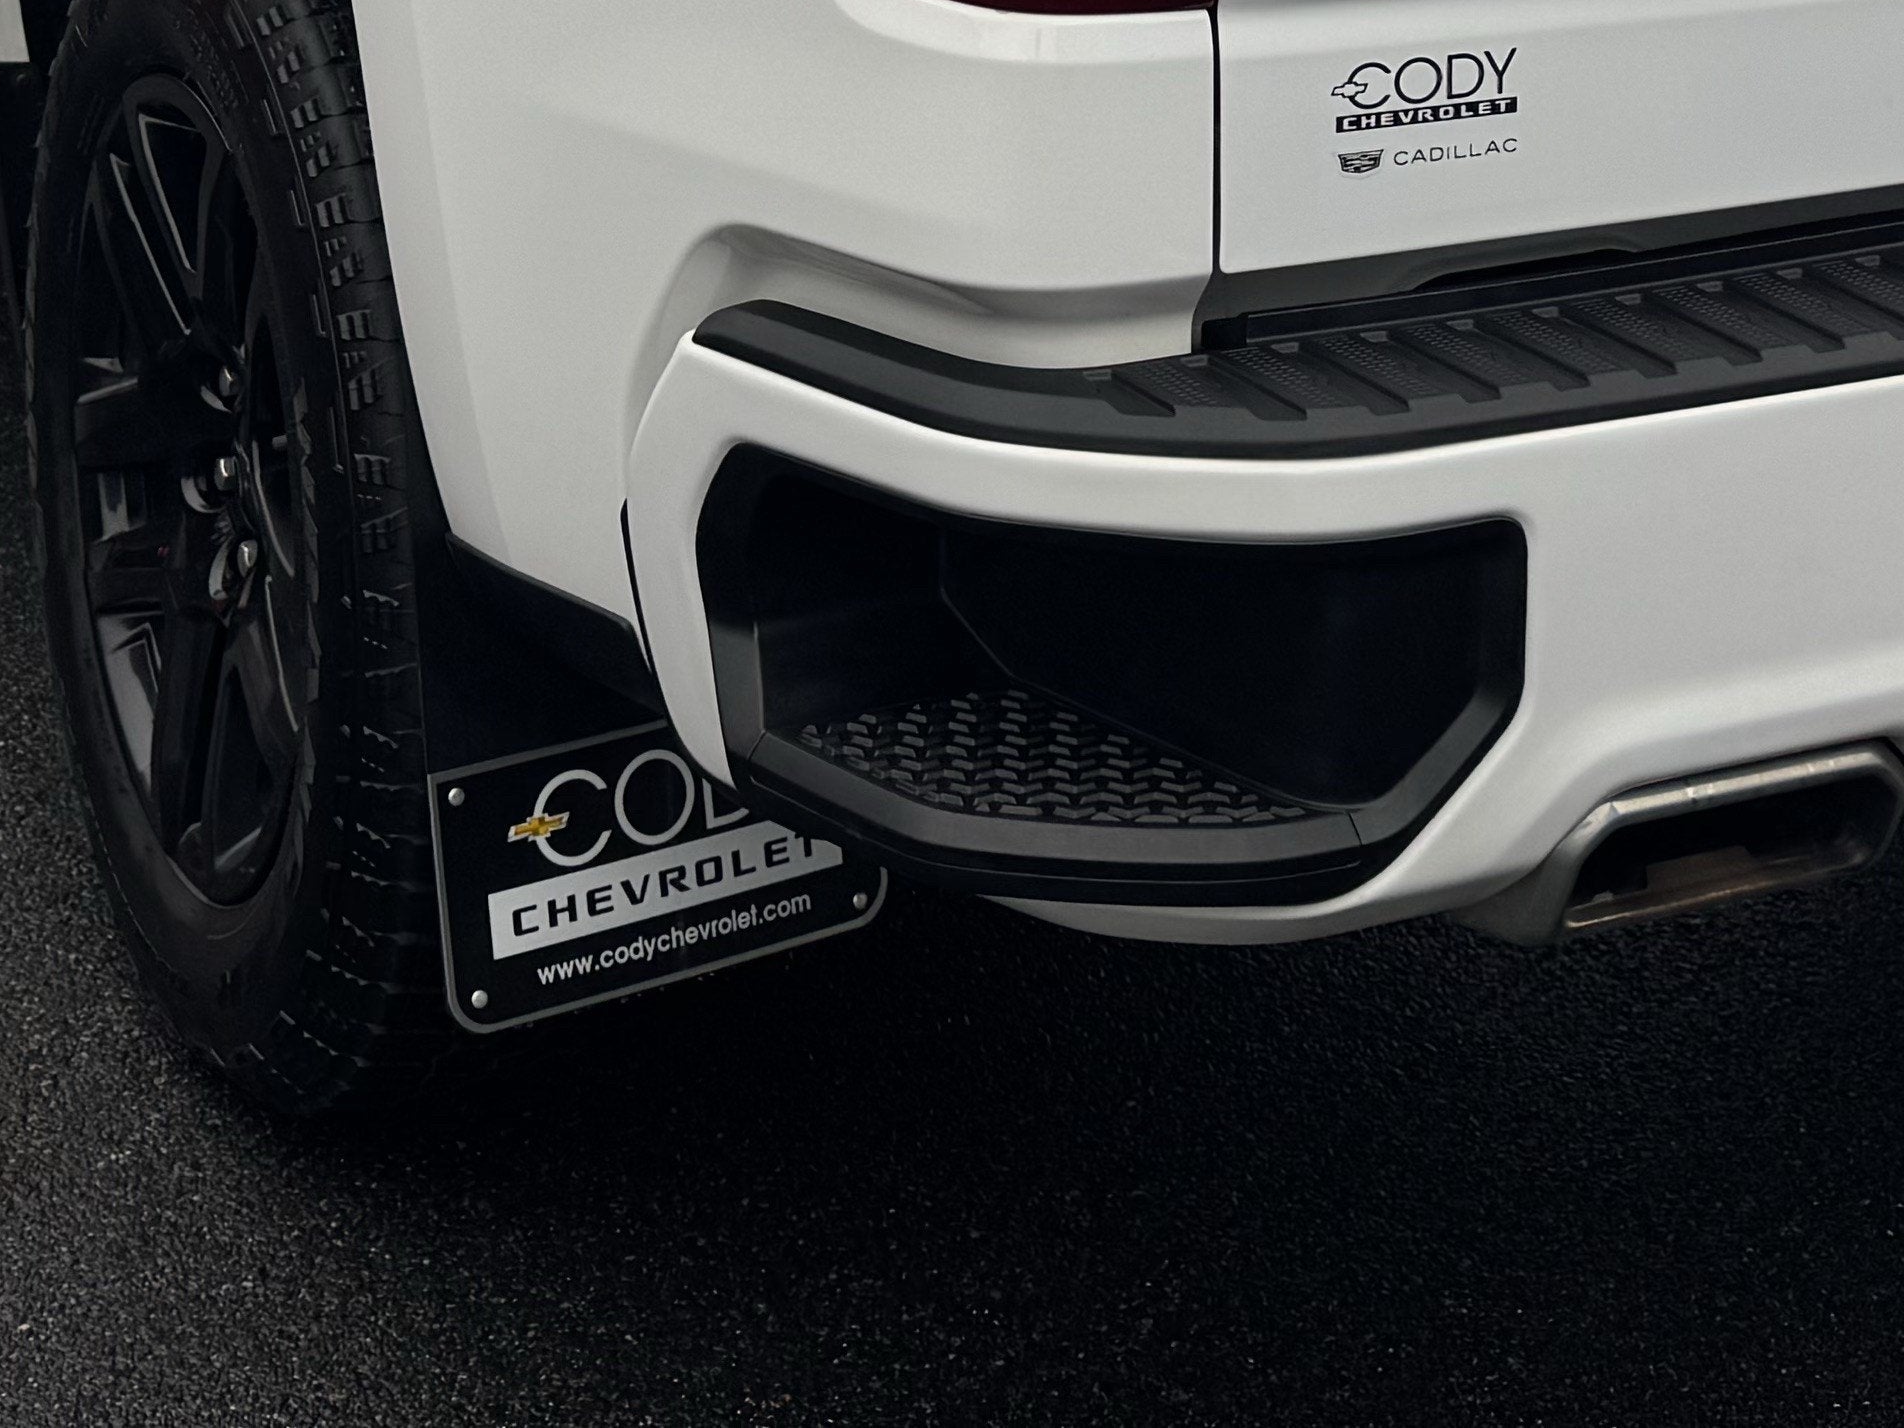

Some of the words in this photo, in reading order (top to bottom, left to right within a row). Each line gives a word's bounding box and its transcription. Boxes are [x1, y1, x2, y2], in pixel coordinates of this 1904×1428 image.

[1341, 46, 1518, 110] CODY
[1342, 98, 1512, 131] CHEVROLET
[1392, 137, 1519, 166] CADILLAC
[531, 748, 750, 867] CO
[536, 893, 812, 986] www.codychevrolet.com
